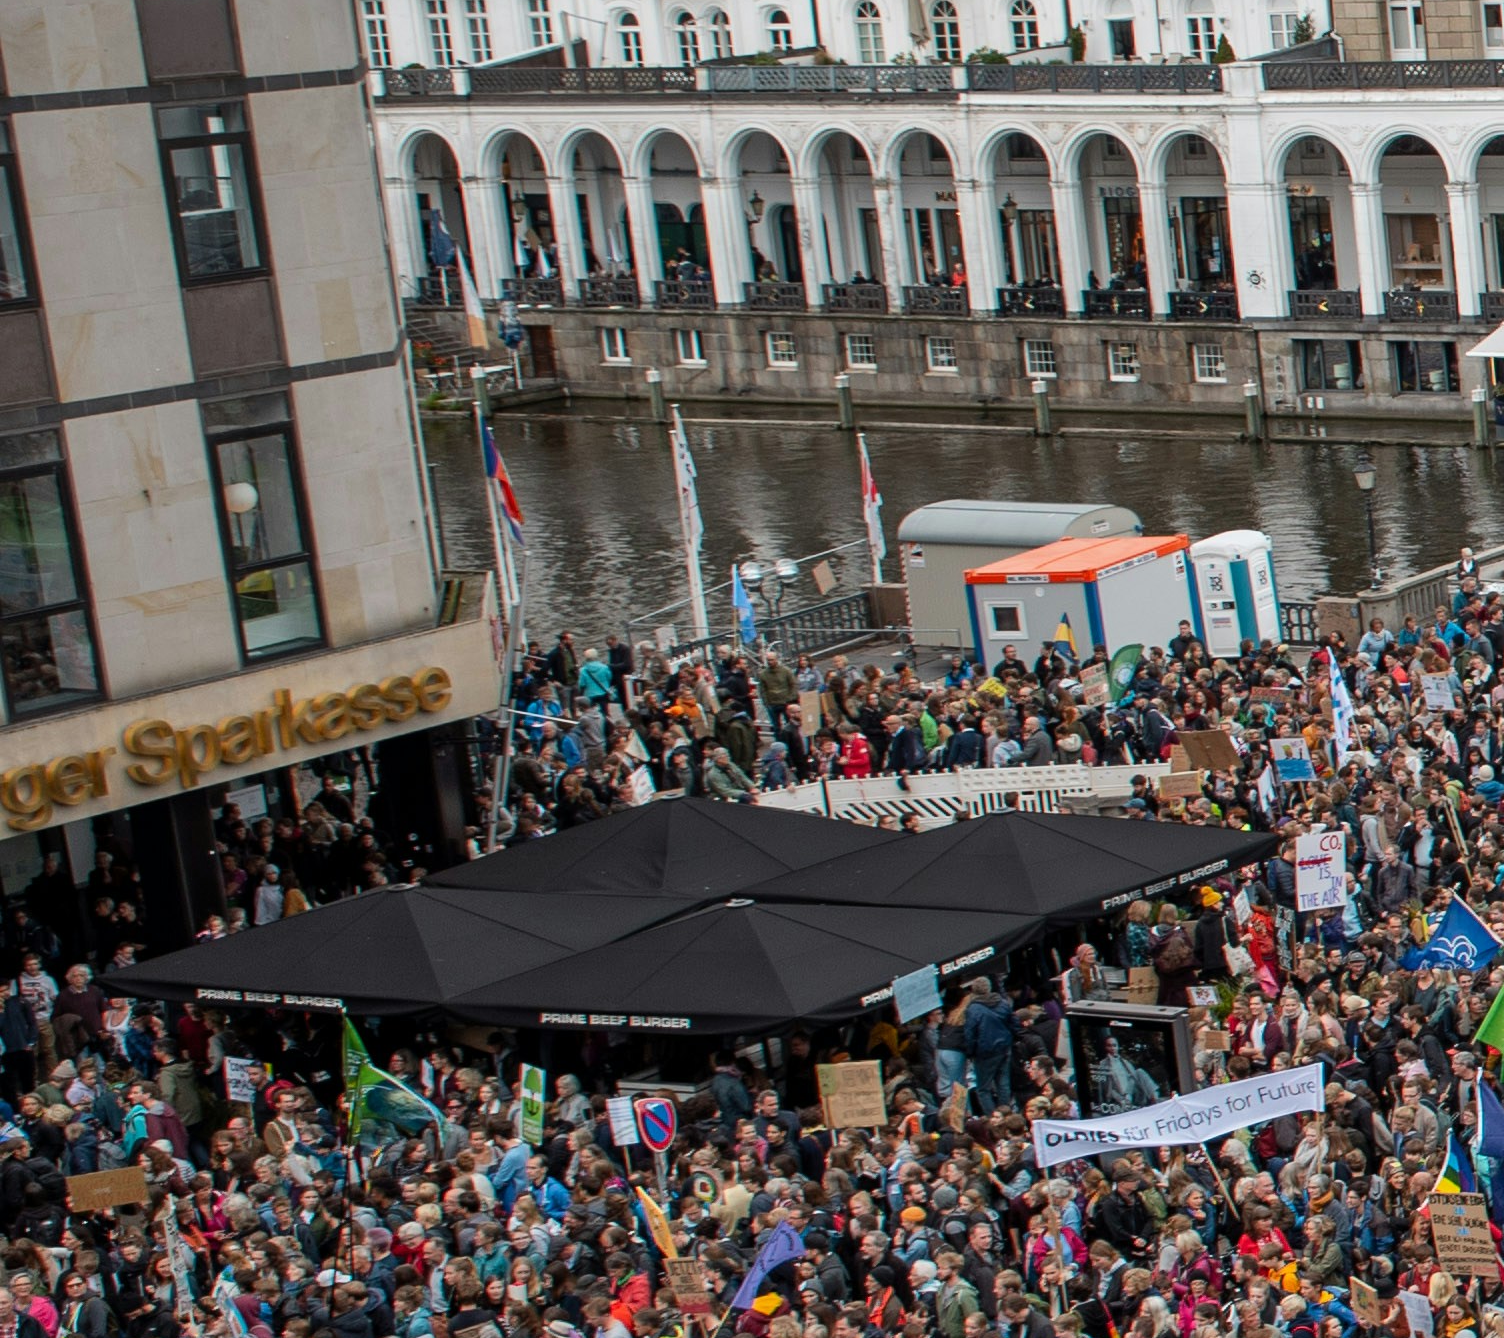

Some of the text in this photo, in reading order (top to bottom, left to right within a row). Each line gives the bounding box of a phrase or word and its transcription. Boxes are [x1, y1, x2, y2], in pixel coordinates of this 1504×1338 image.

[122, 664, 454, 789] Sparkasse
[1318, 867, 1331, 880] IS
[1330, 876, 1342, 888] IN
[1101, 858, 1228, 911] PRIME BEEF BURGER
[1299, 888, 1341, 908] THE AIR
[861, 946, 995, 1007] PRIM BURGER
[196, 988, 344, 1009] PRIME BEEF BURGER
[540, 1011, 691, 1029] PRIME BEEF BURGER
[1044, 1079, 1317, 1149] OLDIES für Fridays for Future
